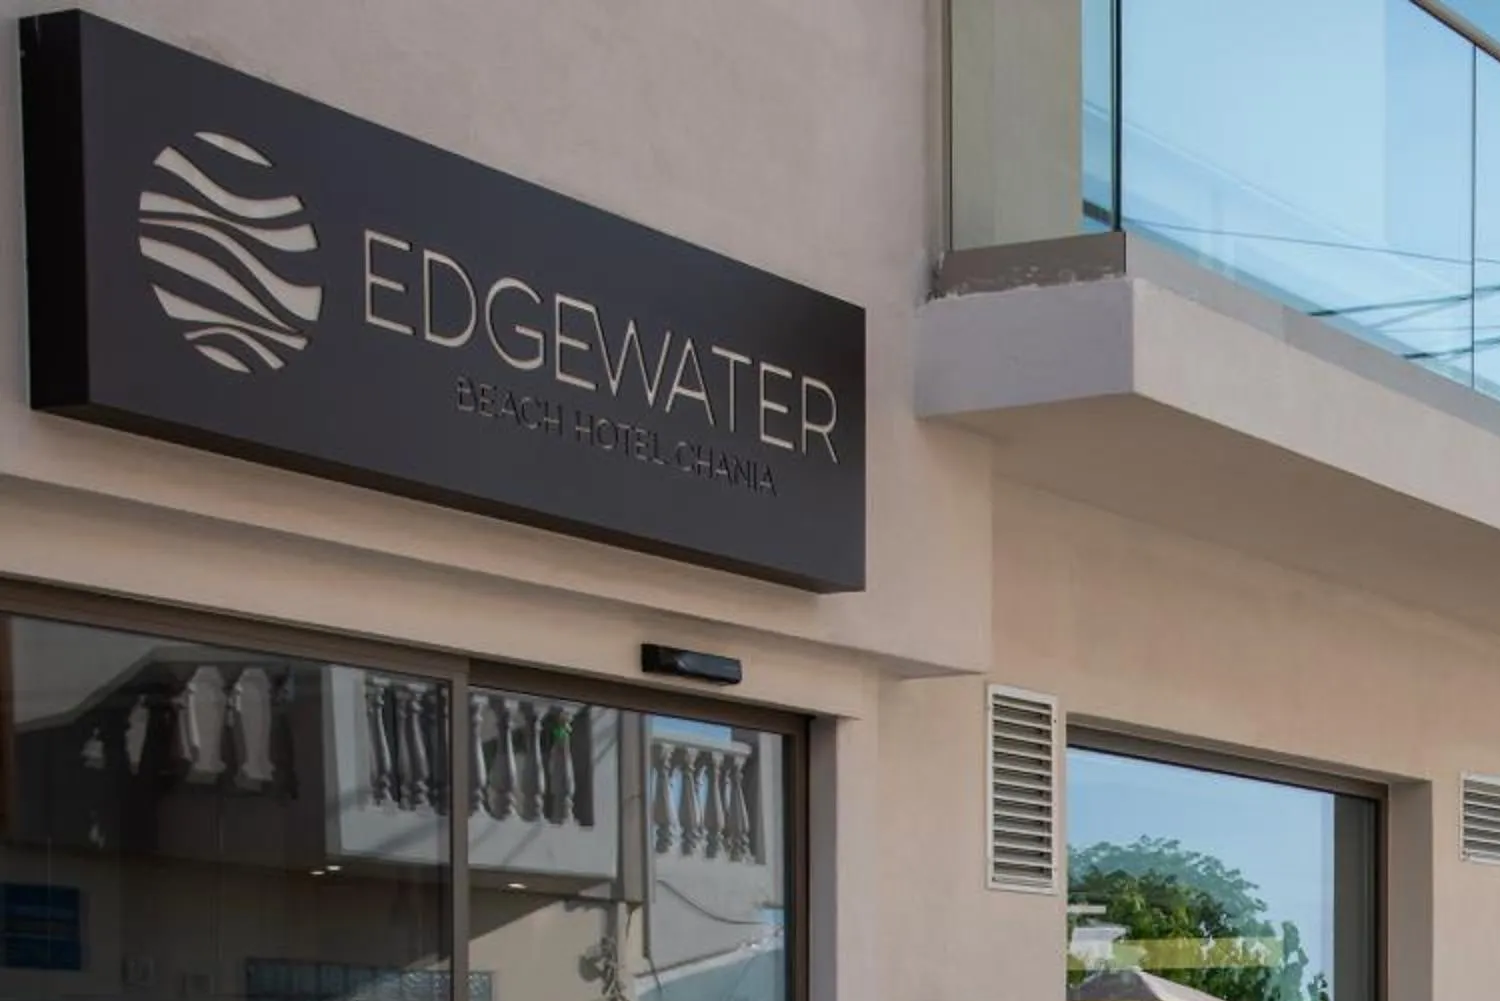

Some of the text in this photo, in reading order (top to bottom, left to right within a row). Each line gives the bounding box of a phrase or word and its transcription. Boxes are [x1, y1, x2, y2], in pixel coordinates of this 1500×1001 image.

[363, 229, 840, 463] EDGEWATER
[456, 376, 777, 497] BEACH HOTEL CHANIA
